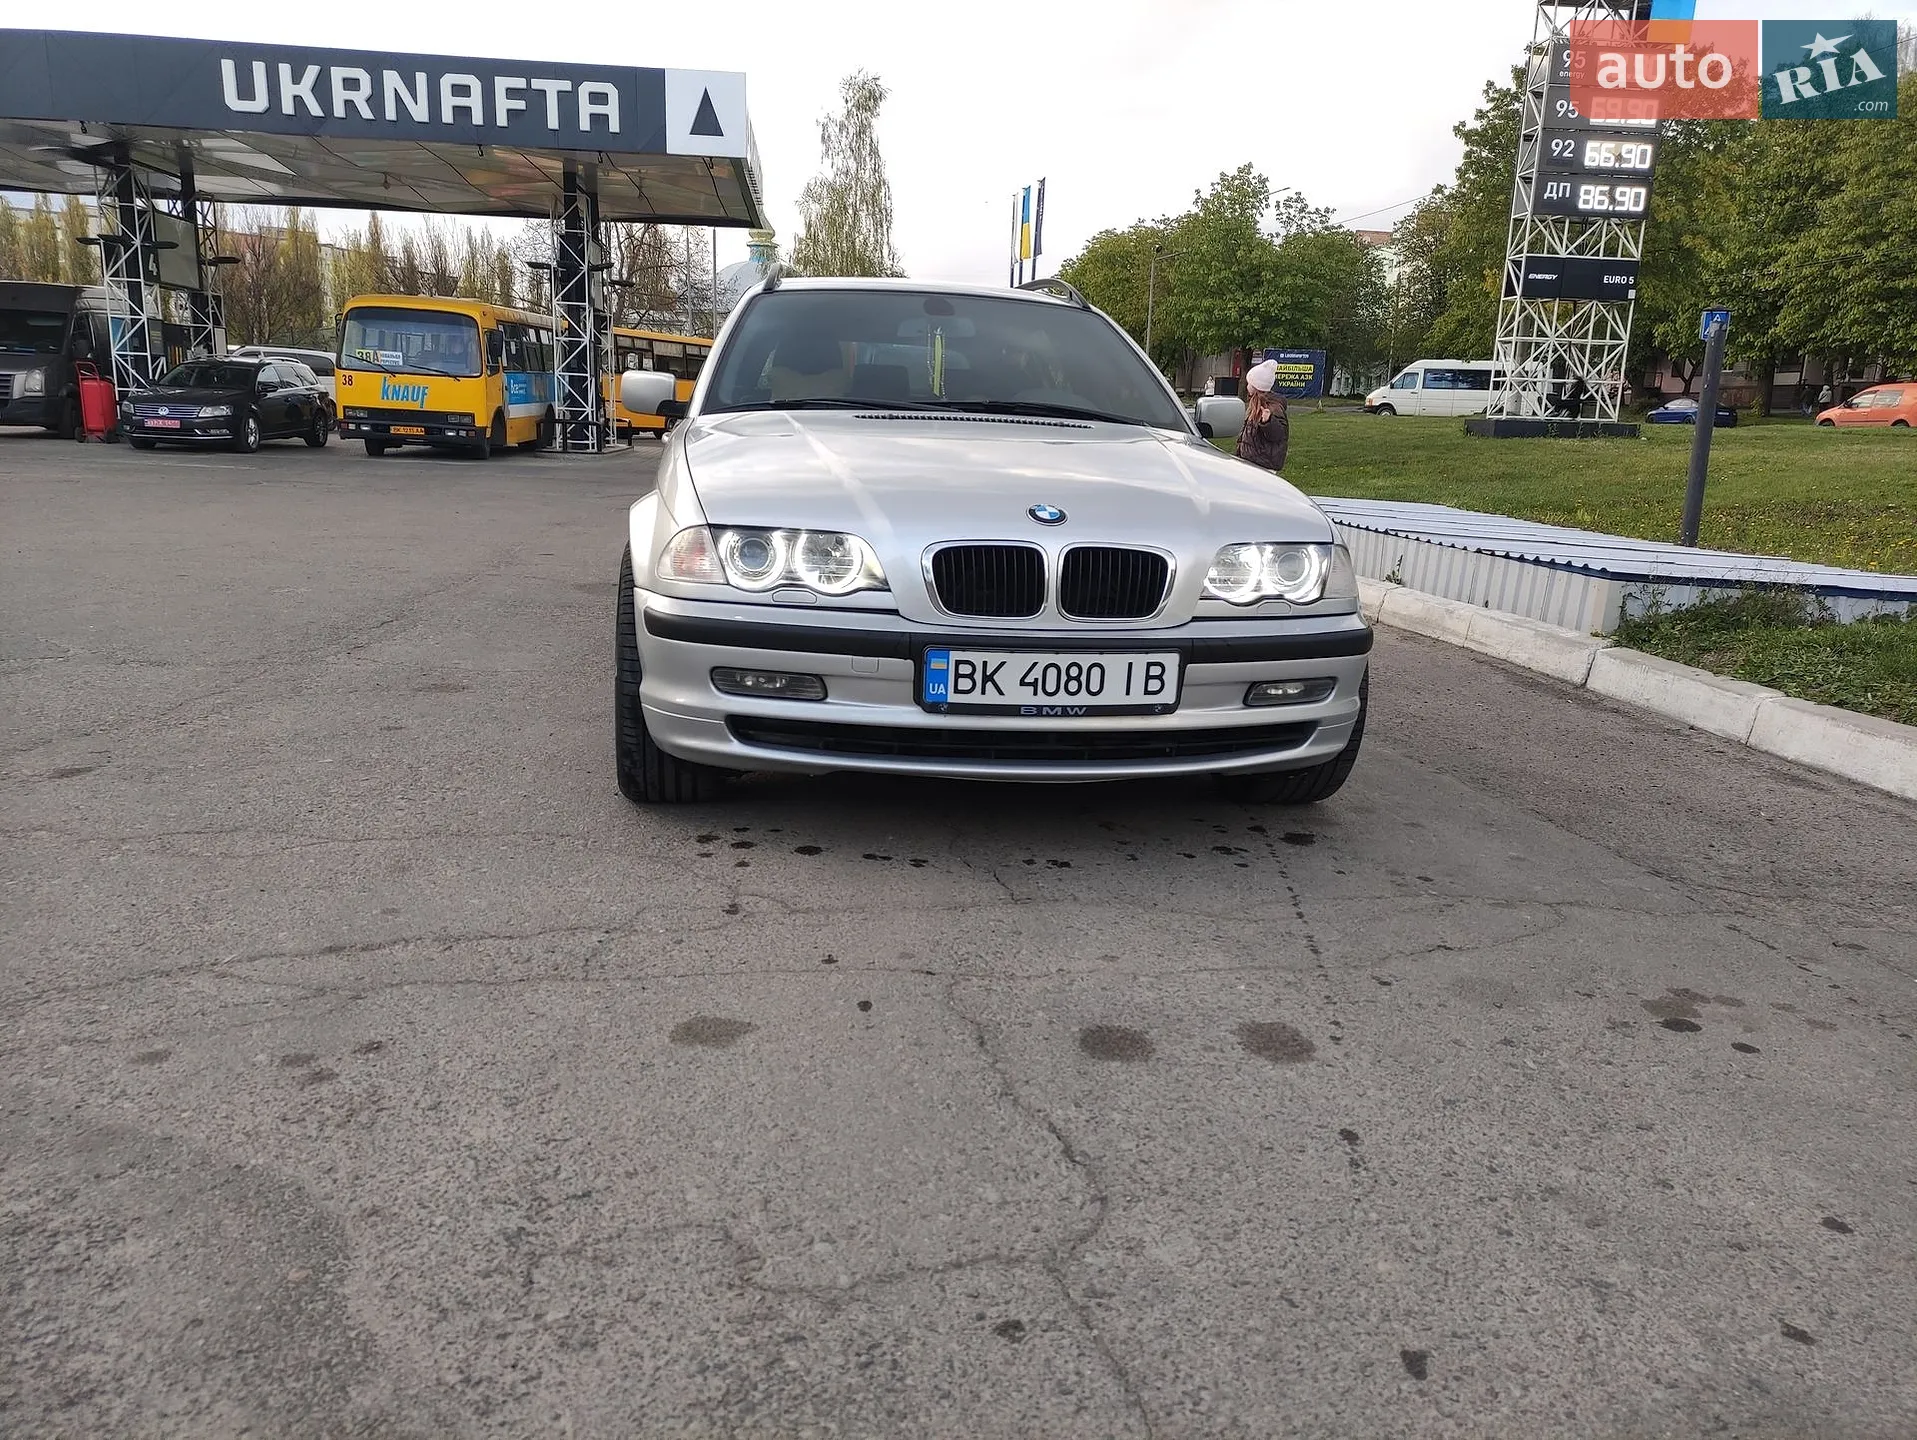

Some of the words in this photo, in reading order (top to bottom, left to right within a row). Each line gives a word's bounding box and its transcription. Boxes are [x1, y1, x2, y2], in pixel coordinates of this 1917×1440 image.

[1562, 50, 1587, 69] 95
[1559, 70, 1586, 80] energy
[220, 58, 621, 134] UKRNAFTA
[1555, 100, 1580, 119] 95
[1551, 139, 1576, 158] 92
[1584, 140, 1652, 169] 66.90
[1544, 182, 1571, 200] ДП
[1578, 184, 1647, 212] 86.90
[1528, 273, 1558, 281] ENERGY
[1603, 275, 1628, 284] EURO
[1629, 276, 1635, 285] 5
[342, 374, 354, 386] 38
[381, 376, 429, 409] KNAUF
[929, 682, 946, 694] UA
[953, 659, 1007, 696] BK
[1019, 661, 1106, 697] 4080
[1125, 661, 1166, 696] IB
[1020, 706, 1087, 716] BMW
